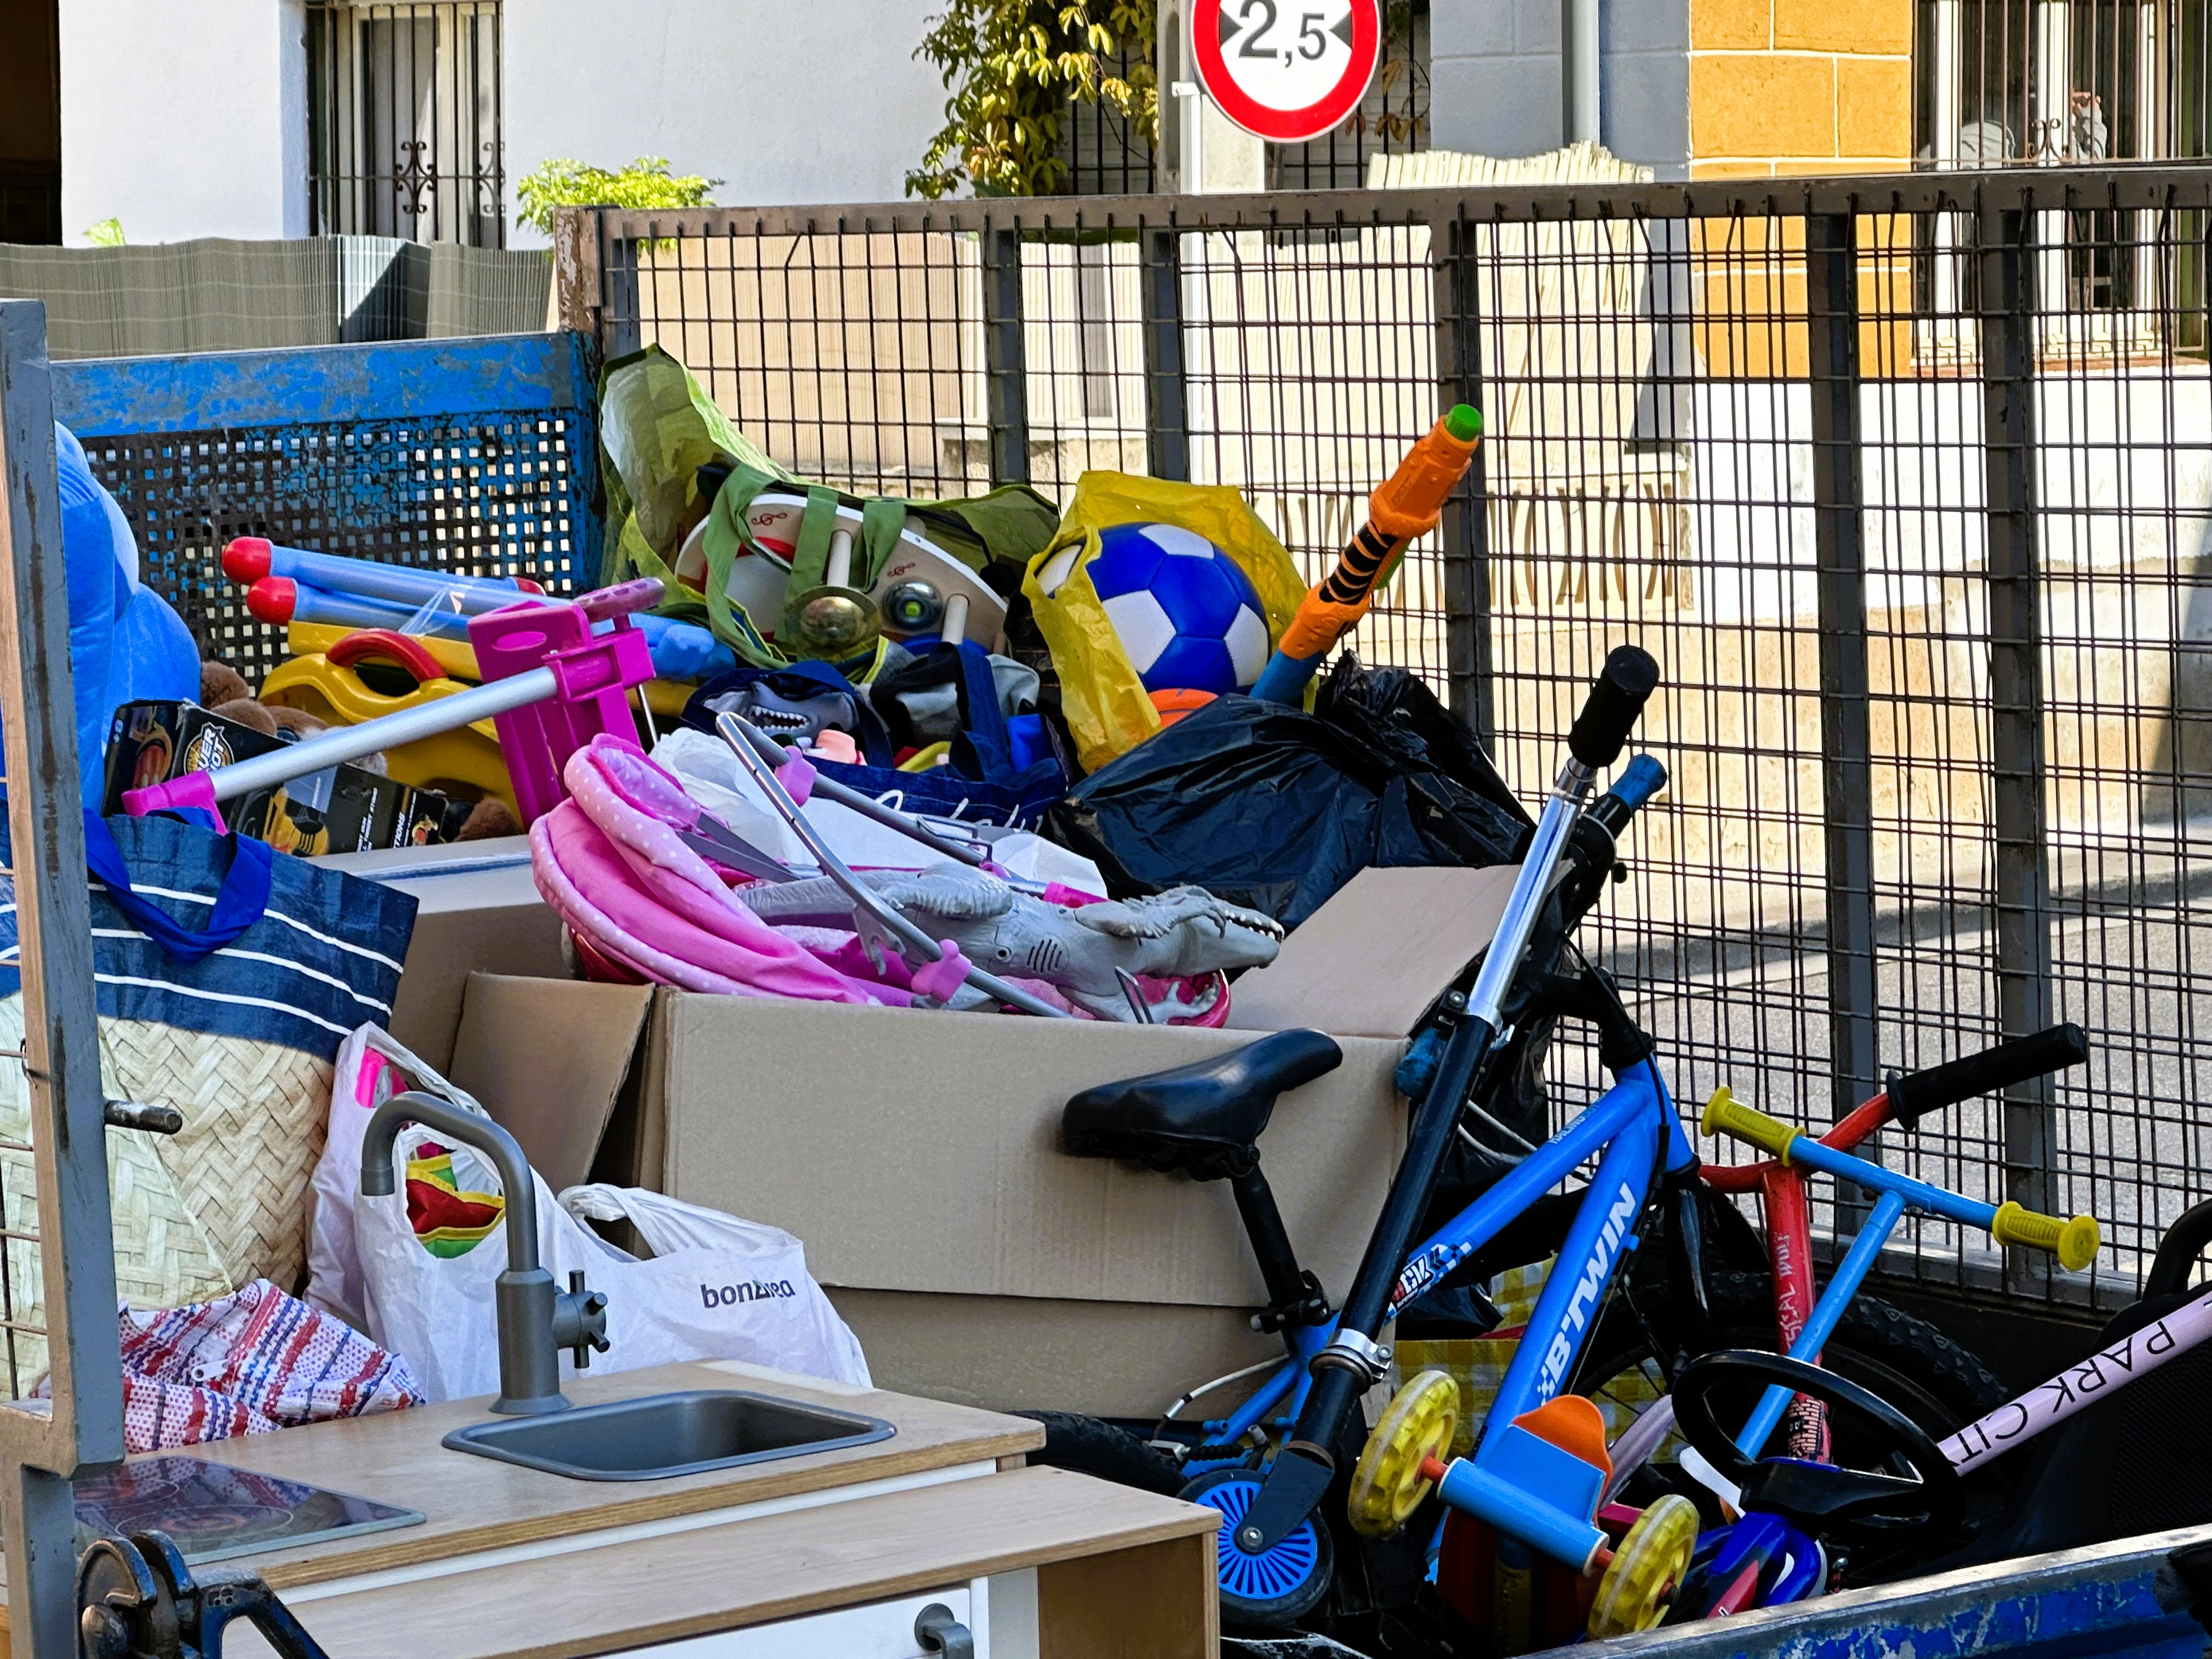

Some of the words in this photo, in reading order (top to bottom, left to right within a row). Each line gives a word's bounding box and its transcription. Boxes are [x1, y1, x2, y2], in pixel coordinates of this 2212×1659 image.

[1239, 0, 1327, 68] 2,5
[393, 811, 405, 848] TIONS
[2039, 1321, 2176, 1413] PARK
[1951, 1403, 2028, 1467] CIT
